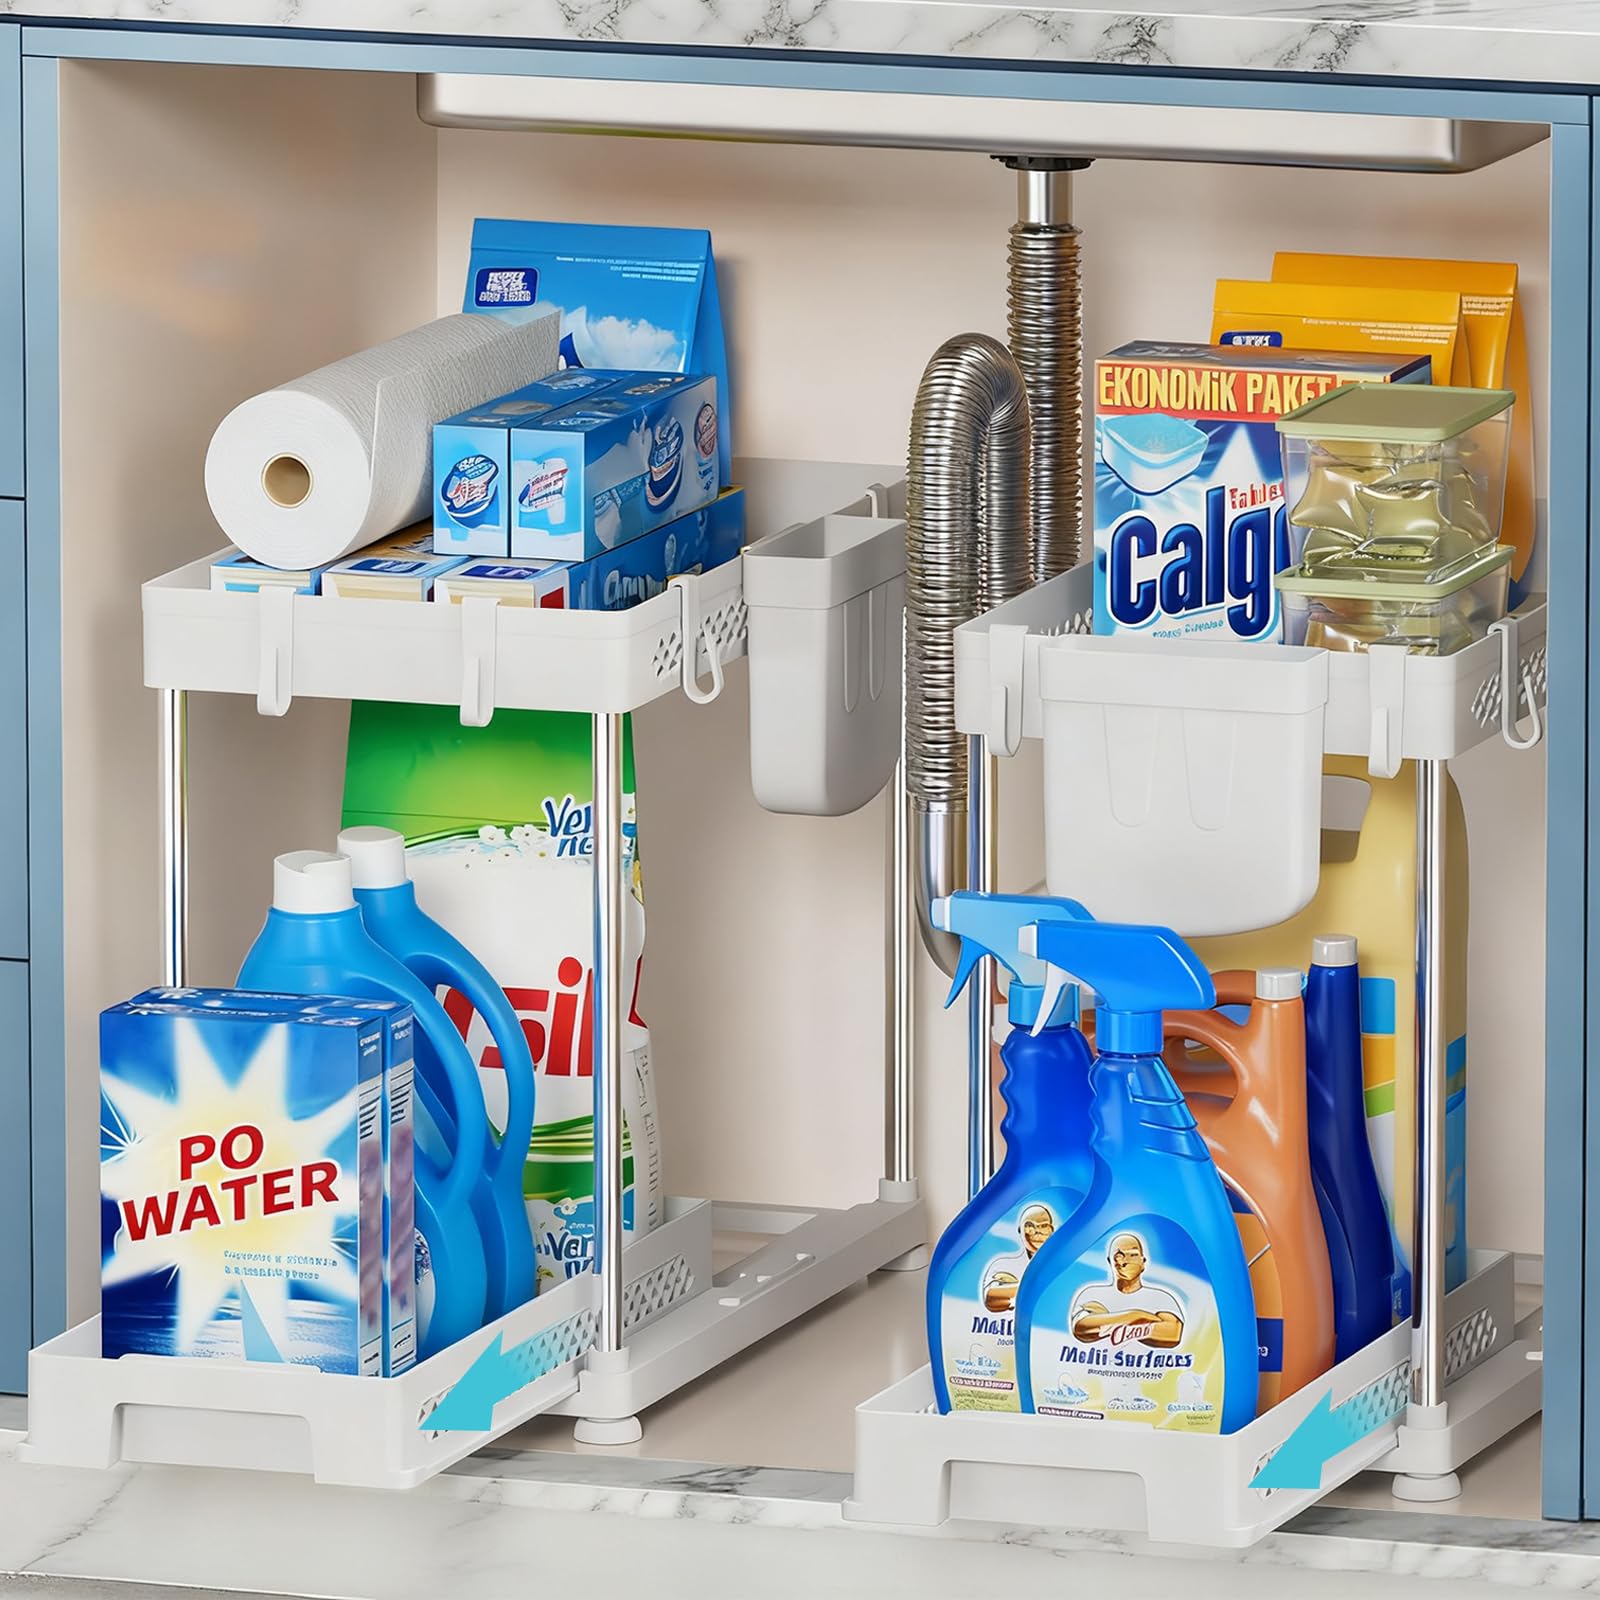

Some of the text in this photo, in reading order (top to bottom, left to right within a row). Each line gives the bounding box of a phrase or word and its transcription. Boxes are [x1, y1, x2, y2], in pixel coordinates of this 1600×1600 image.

[443, 956, 593, 1077] sil
[179, 1124, 264, 1182] PO
[121, 1161, 340, 1242] WATER
